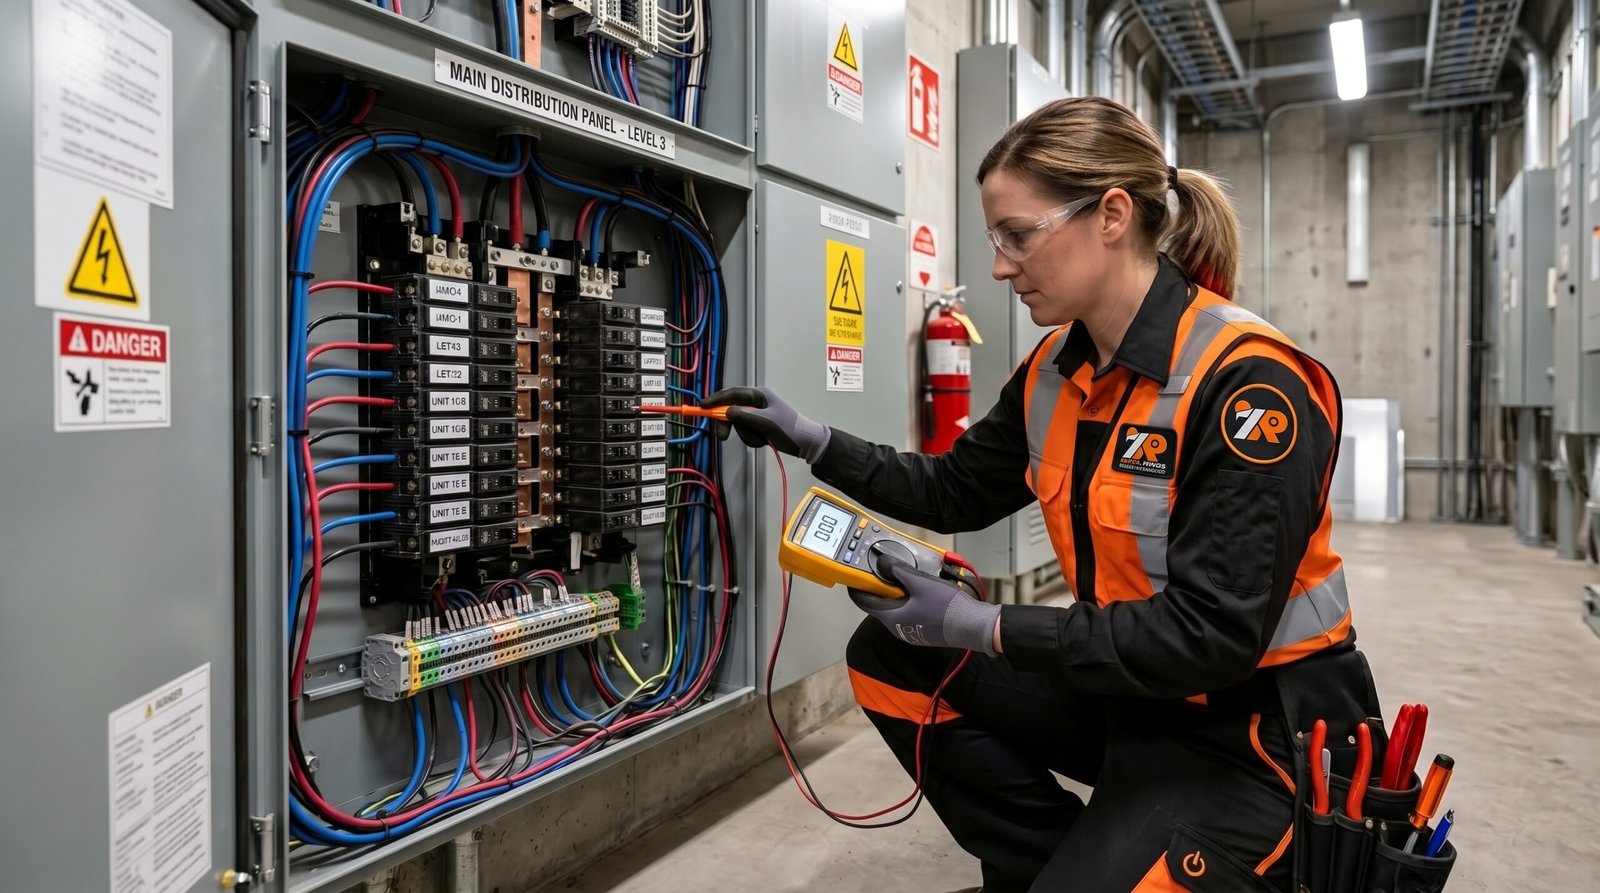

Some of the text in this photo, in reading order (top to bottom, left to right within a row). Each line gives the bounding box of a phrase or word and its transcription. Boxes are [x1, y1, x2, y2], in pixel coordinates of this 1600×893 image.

[450, 61, 487, 90] MAIN
[491, 75, 578, 121] DISTRIBUTION
[582, 109, 617, 134] PANEL
[628, 125, 658, 148] LEVEL
[660, 137, 666, 150] 3
[92, 329, 162, 358] DANGER
[837, 350, 861, 362] DANGER
[432, 397, 450, 406] UNIT
[432, 425, 450, 434] UNIT
[432, 453, 450, 463] UNIT
[432, 480, 450, 490] UNIT
[432, 508, 450, 518] UNIT
